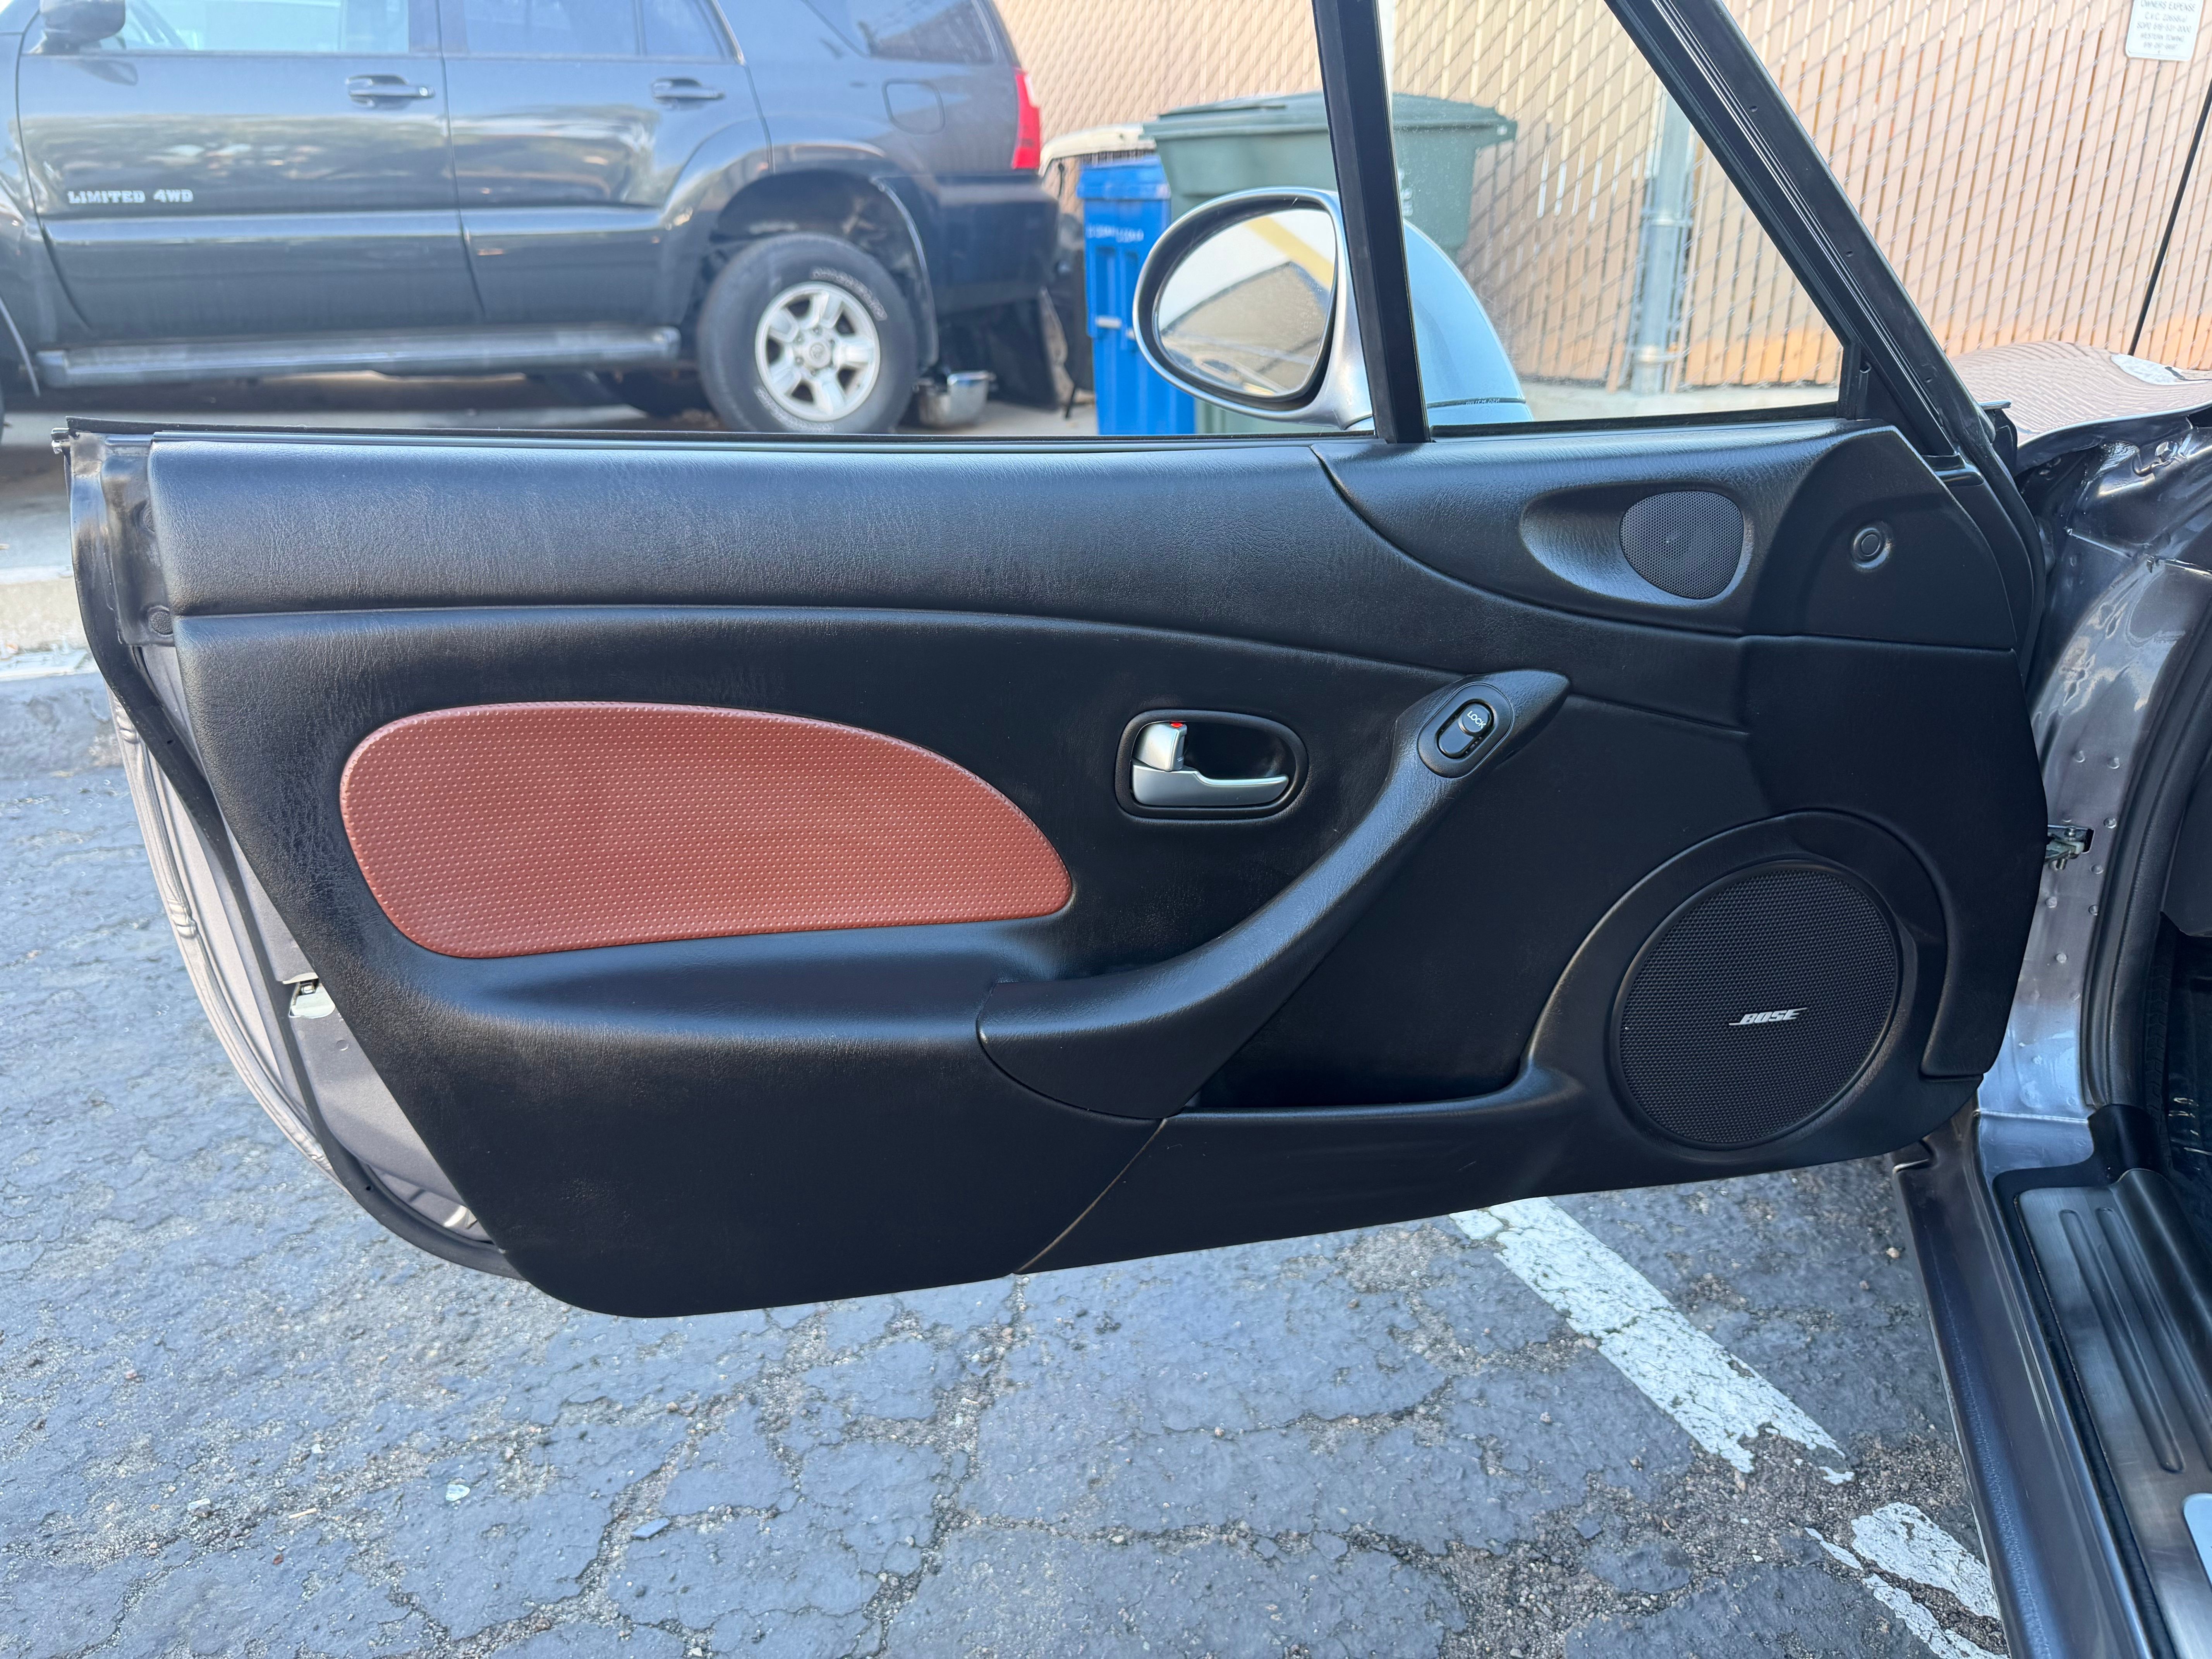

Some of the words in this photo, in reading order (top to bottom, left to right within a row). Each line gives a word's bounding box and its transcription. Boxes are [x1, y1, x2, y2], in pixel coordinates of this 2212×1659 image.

[67, 191, 146, 204] LIMITED
[153, 189, 193, 203] 4WD
[1467, 711, 1486, 729] LOCK
[1729, 1007, 1807, 1026] BOSE
